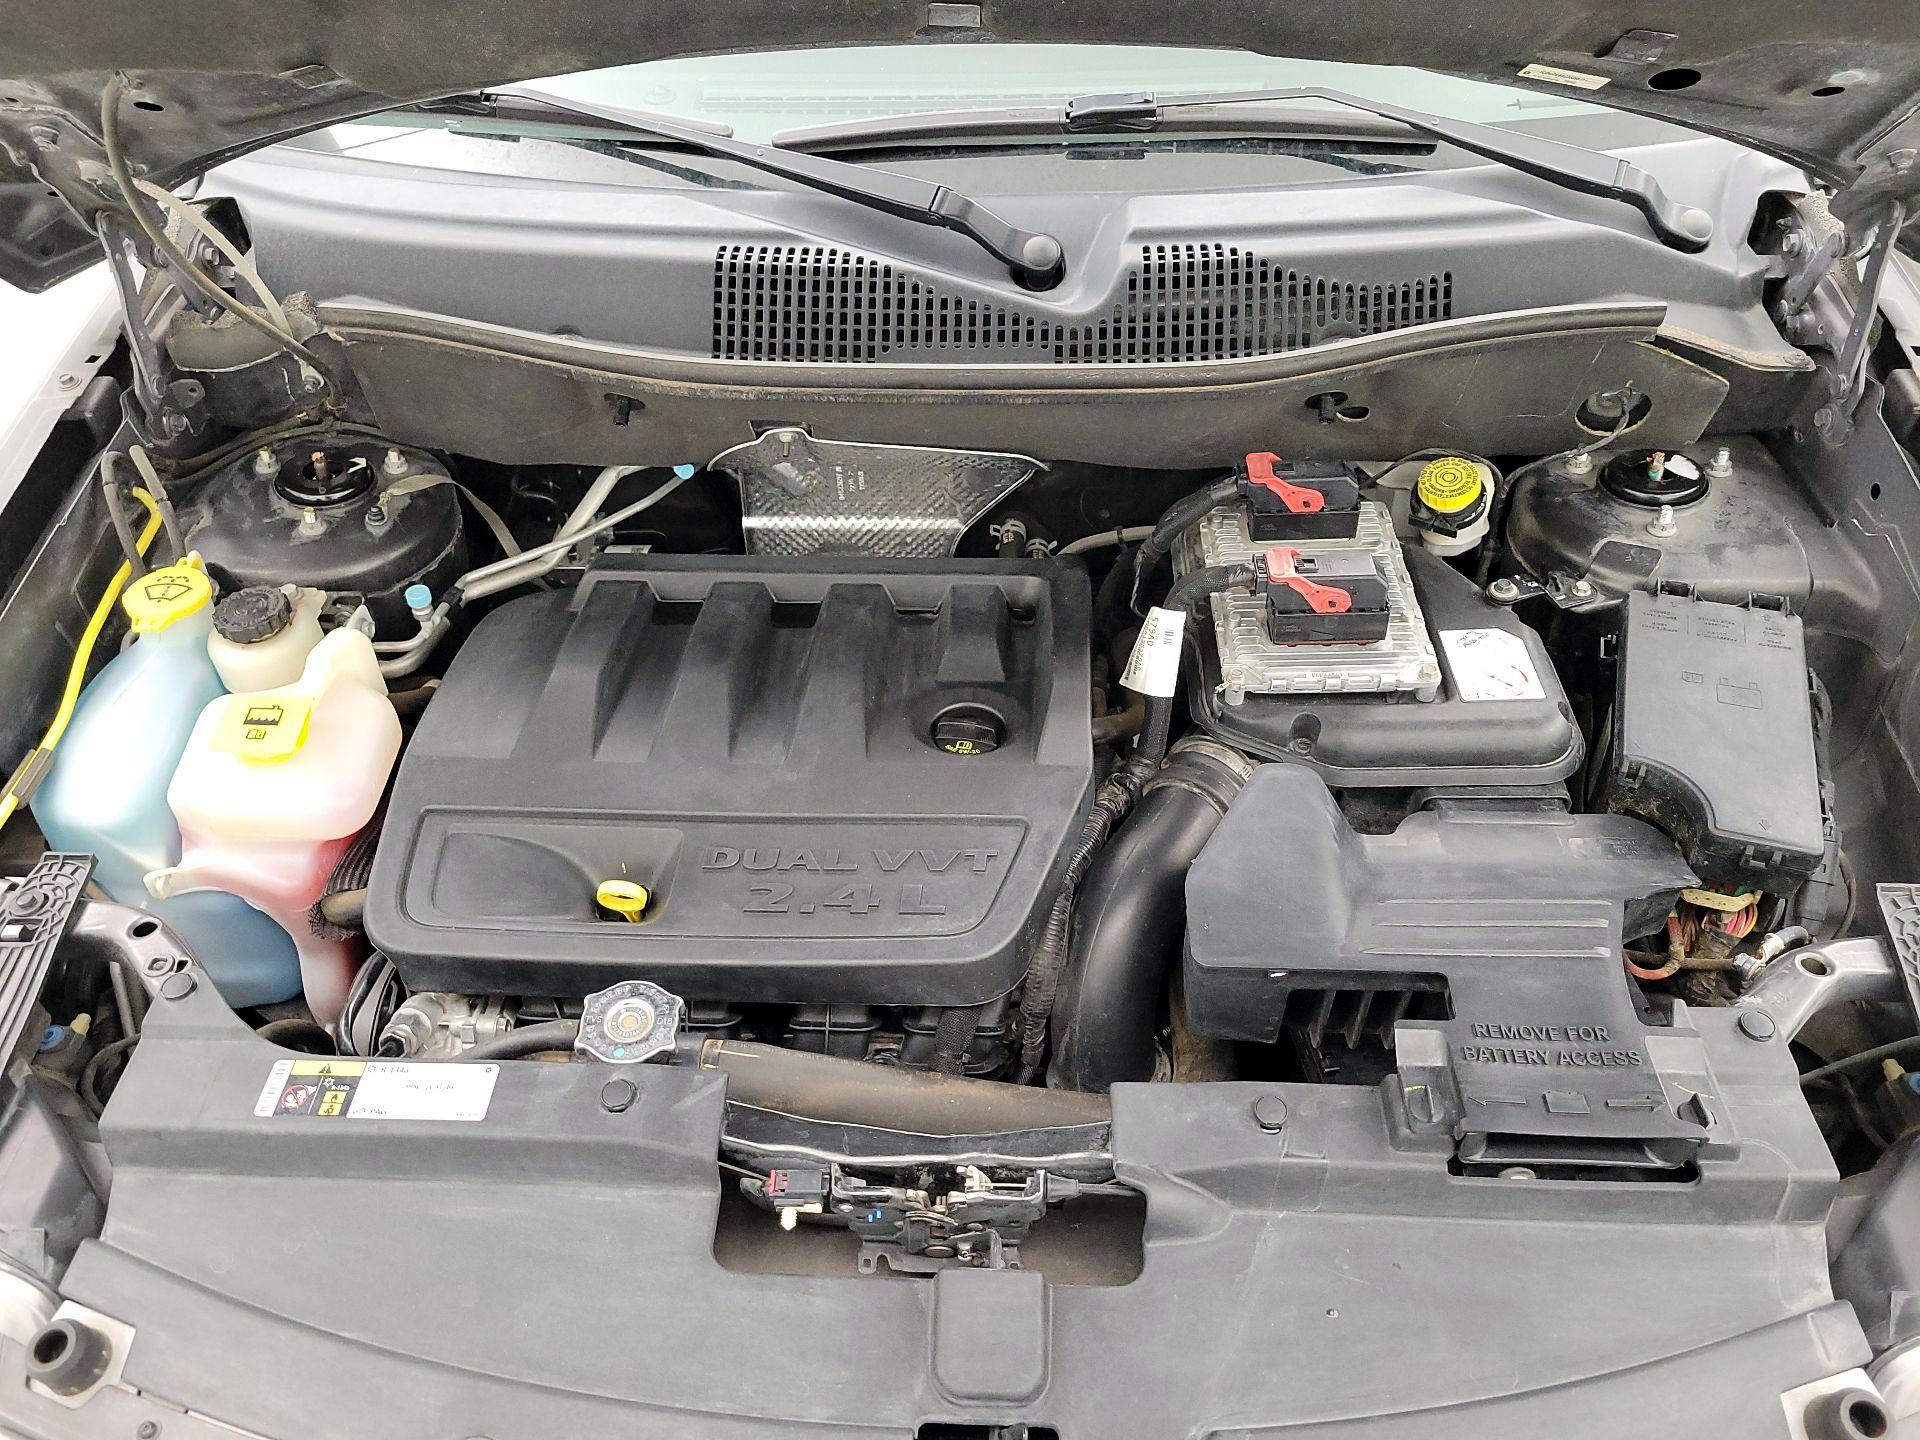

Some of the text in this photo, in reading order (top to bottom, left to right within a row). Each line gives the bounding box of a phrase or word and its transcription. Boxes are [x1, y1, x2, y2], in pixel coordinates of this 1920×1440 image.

[702, 847, 998, 872] DUAL VVT
[585, 1015, 672, 1025] TVS D18
[1472, 1023, 1611, 1042] REMOVE FOR
[1463, 1045, 1642, 1066] BATTERY ACCESS
